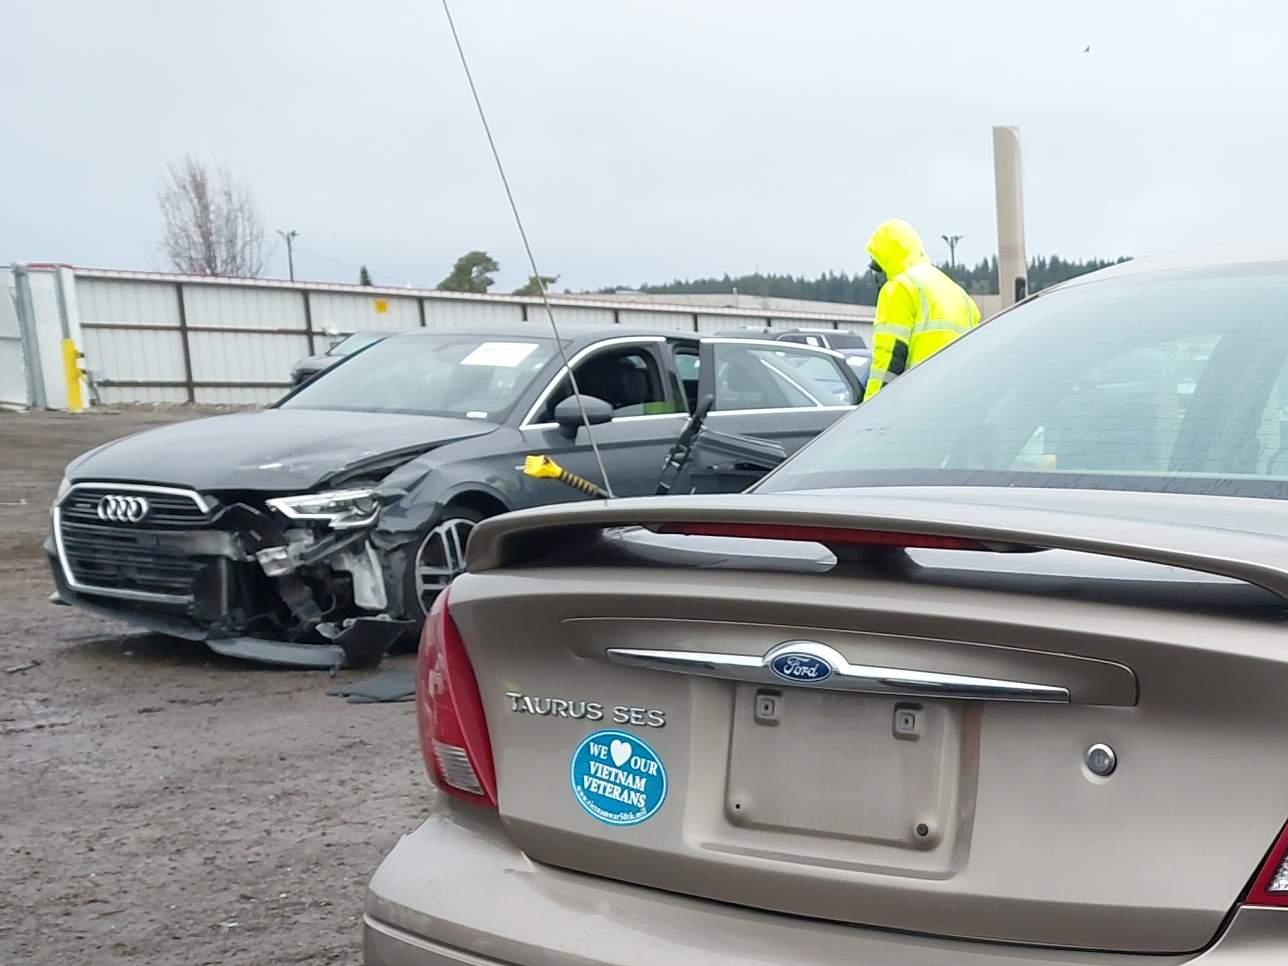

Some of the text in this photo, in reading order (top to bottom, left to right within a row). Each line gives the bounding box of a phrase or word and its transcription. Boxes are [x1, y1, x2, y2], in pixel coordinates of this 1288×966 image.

[783, 656, 819, 677] Ford
[506, 692, 666, 728] TAURUS SES
[589, 742, 658, 776] WE OUR
[583, 775, 647, 808] VETERANS
[589, 761, 647, 792] VIETNAM
